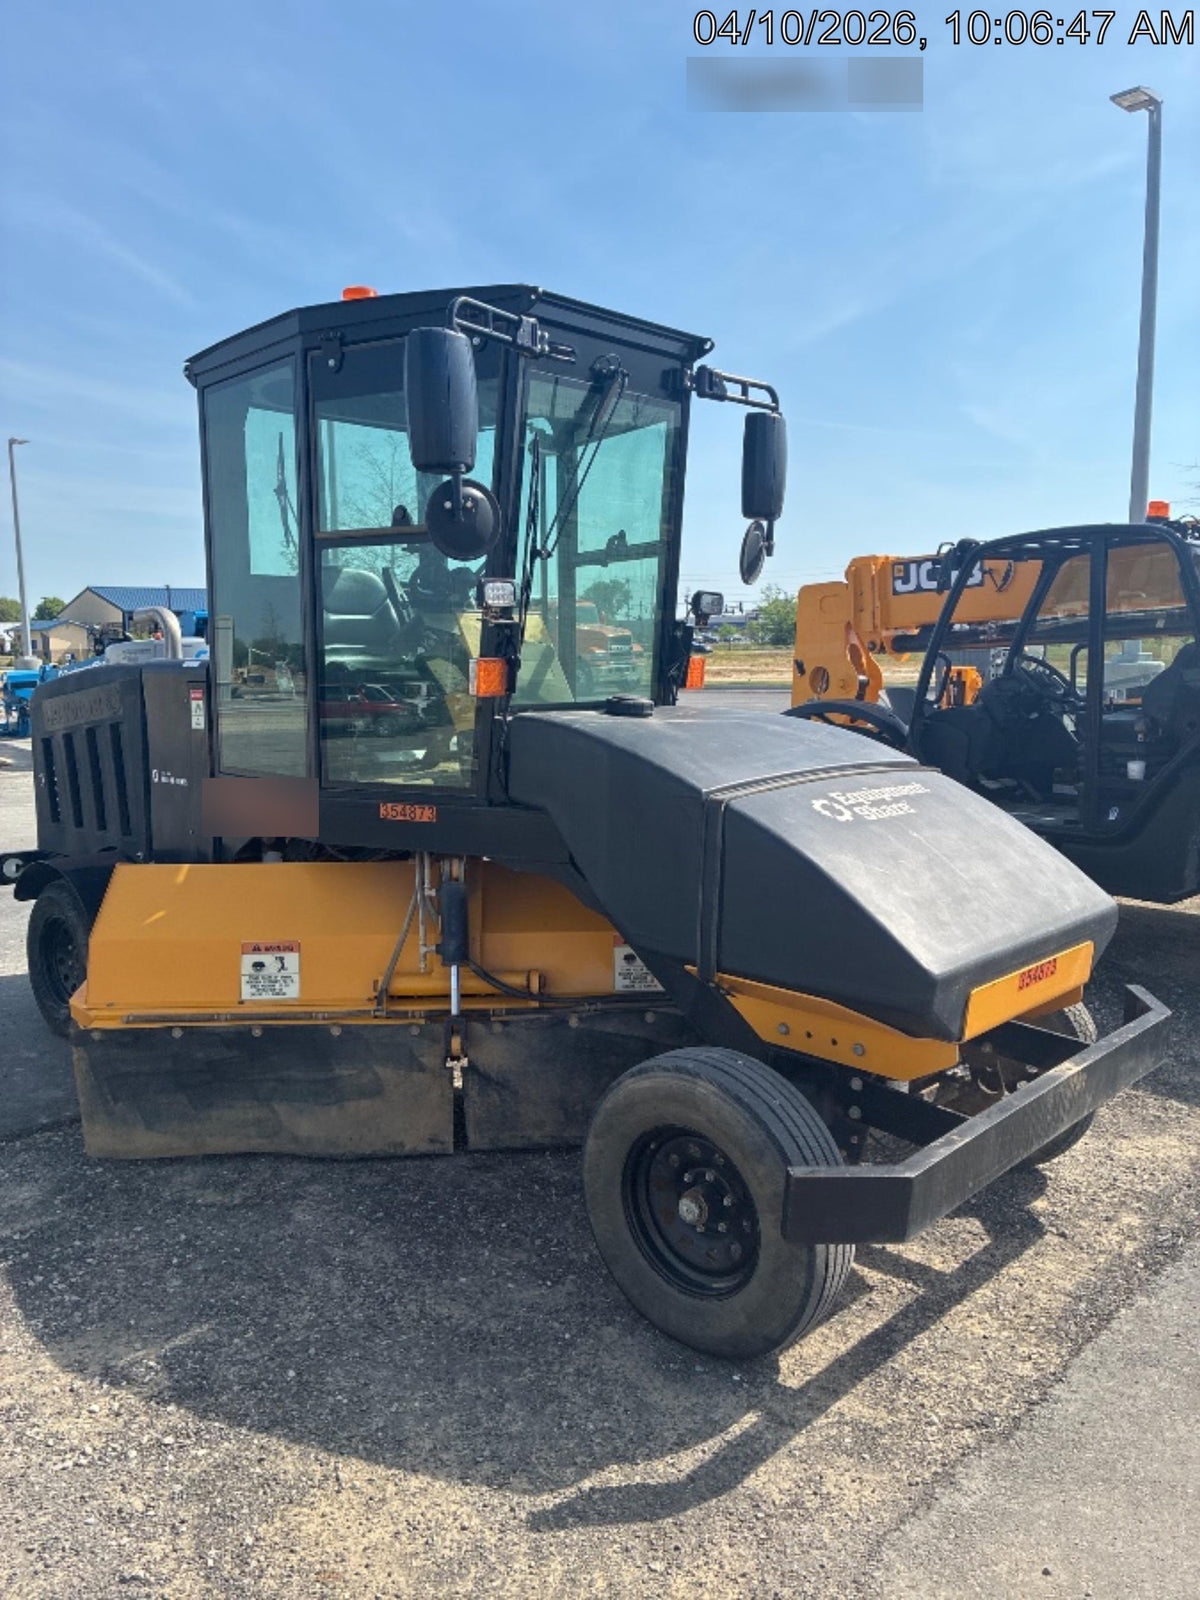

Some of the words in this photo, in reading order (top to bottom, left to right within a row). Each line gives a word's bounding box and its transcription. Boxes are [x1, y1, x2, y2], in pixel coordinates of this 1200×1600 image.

[828, 782, 931, 805] Equipment
[380, 802, 436, 822] 354873
[853, 801, 916, 820] Share
